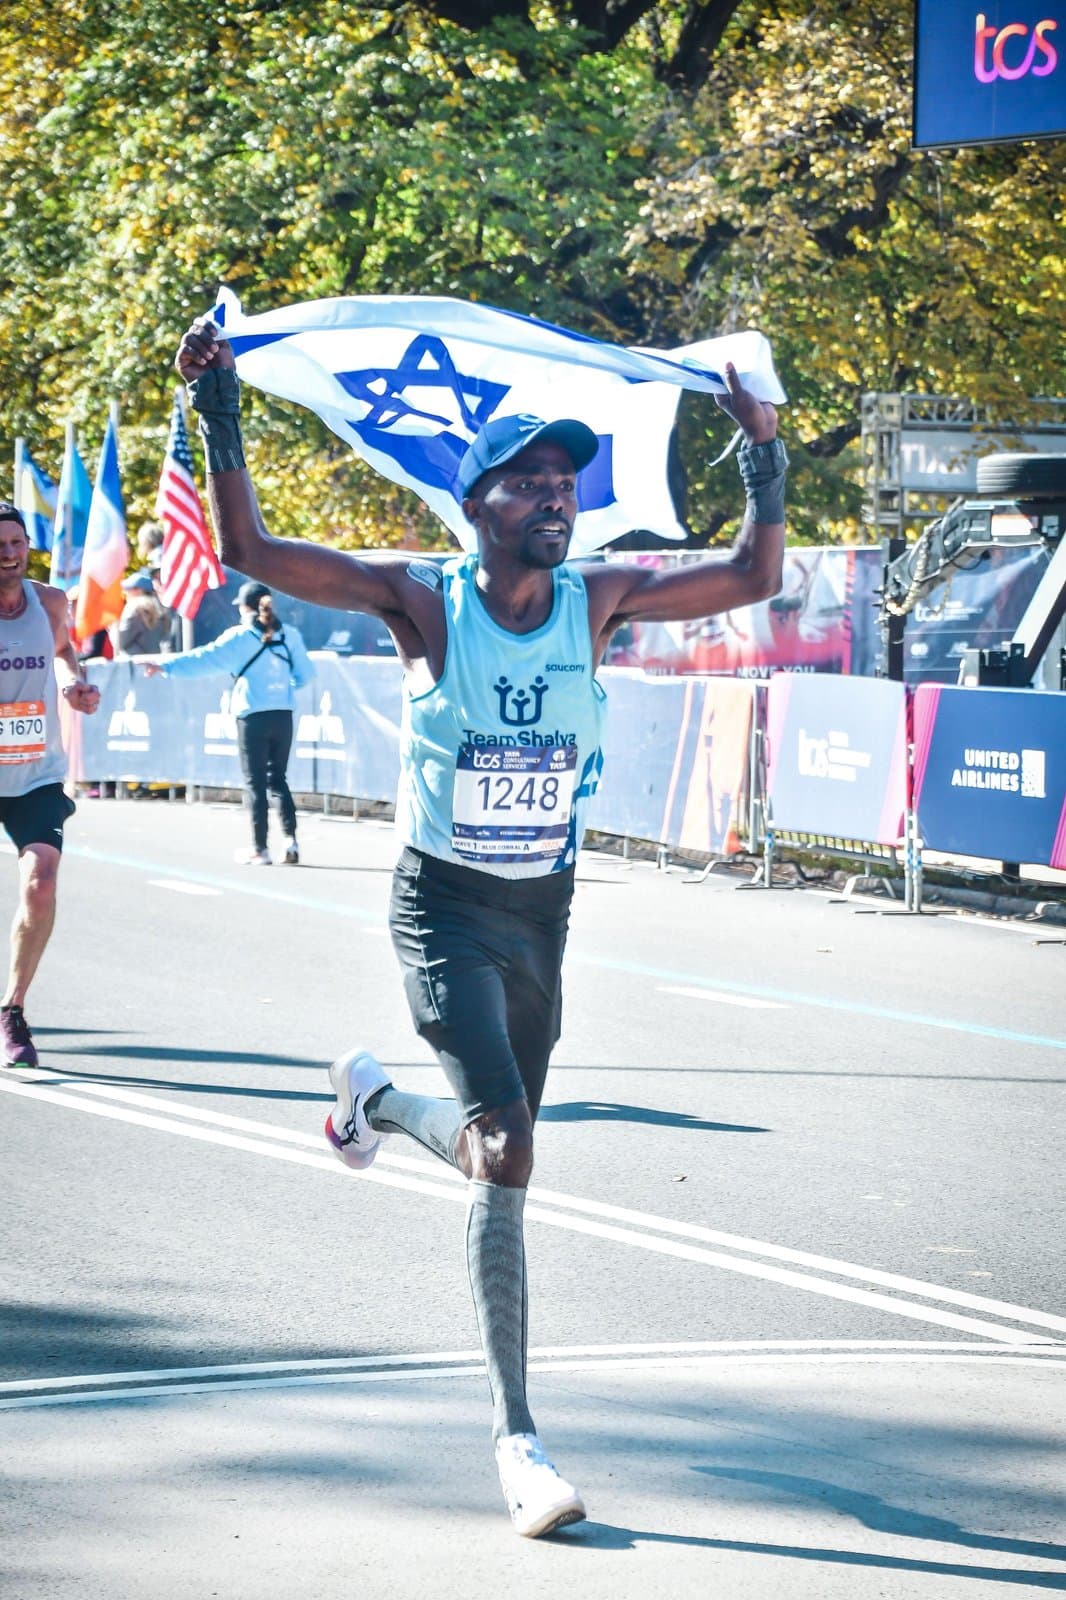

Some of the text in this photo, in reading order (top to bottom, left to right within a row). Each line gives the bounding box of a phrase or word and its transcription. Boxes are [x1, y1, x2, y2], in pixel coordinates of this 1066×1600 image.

[974, 13, 1058, 84] tcs
[545, 664, 585, 673] saucony
[9, 719, 43, 735] 1670
[473, 750, 501, 768] tcs
[964, 749, 1019, 770] UNITED
[951, 769, 1019, 791] AIRLINES
[477, 776, 559, 811] 1248
[523, 843, 529, 851] A
